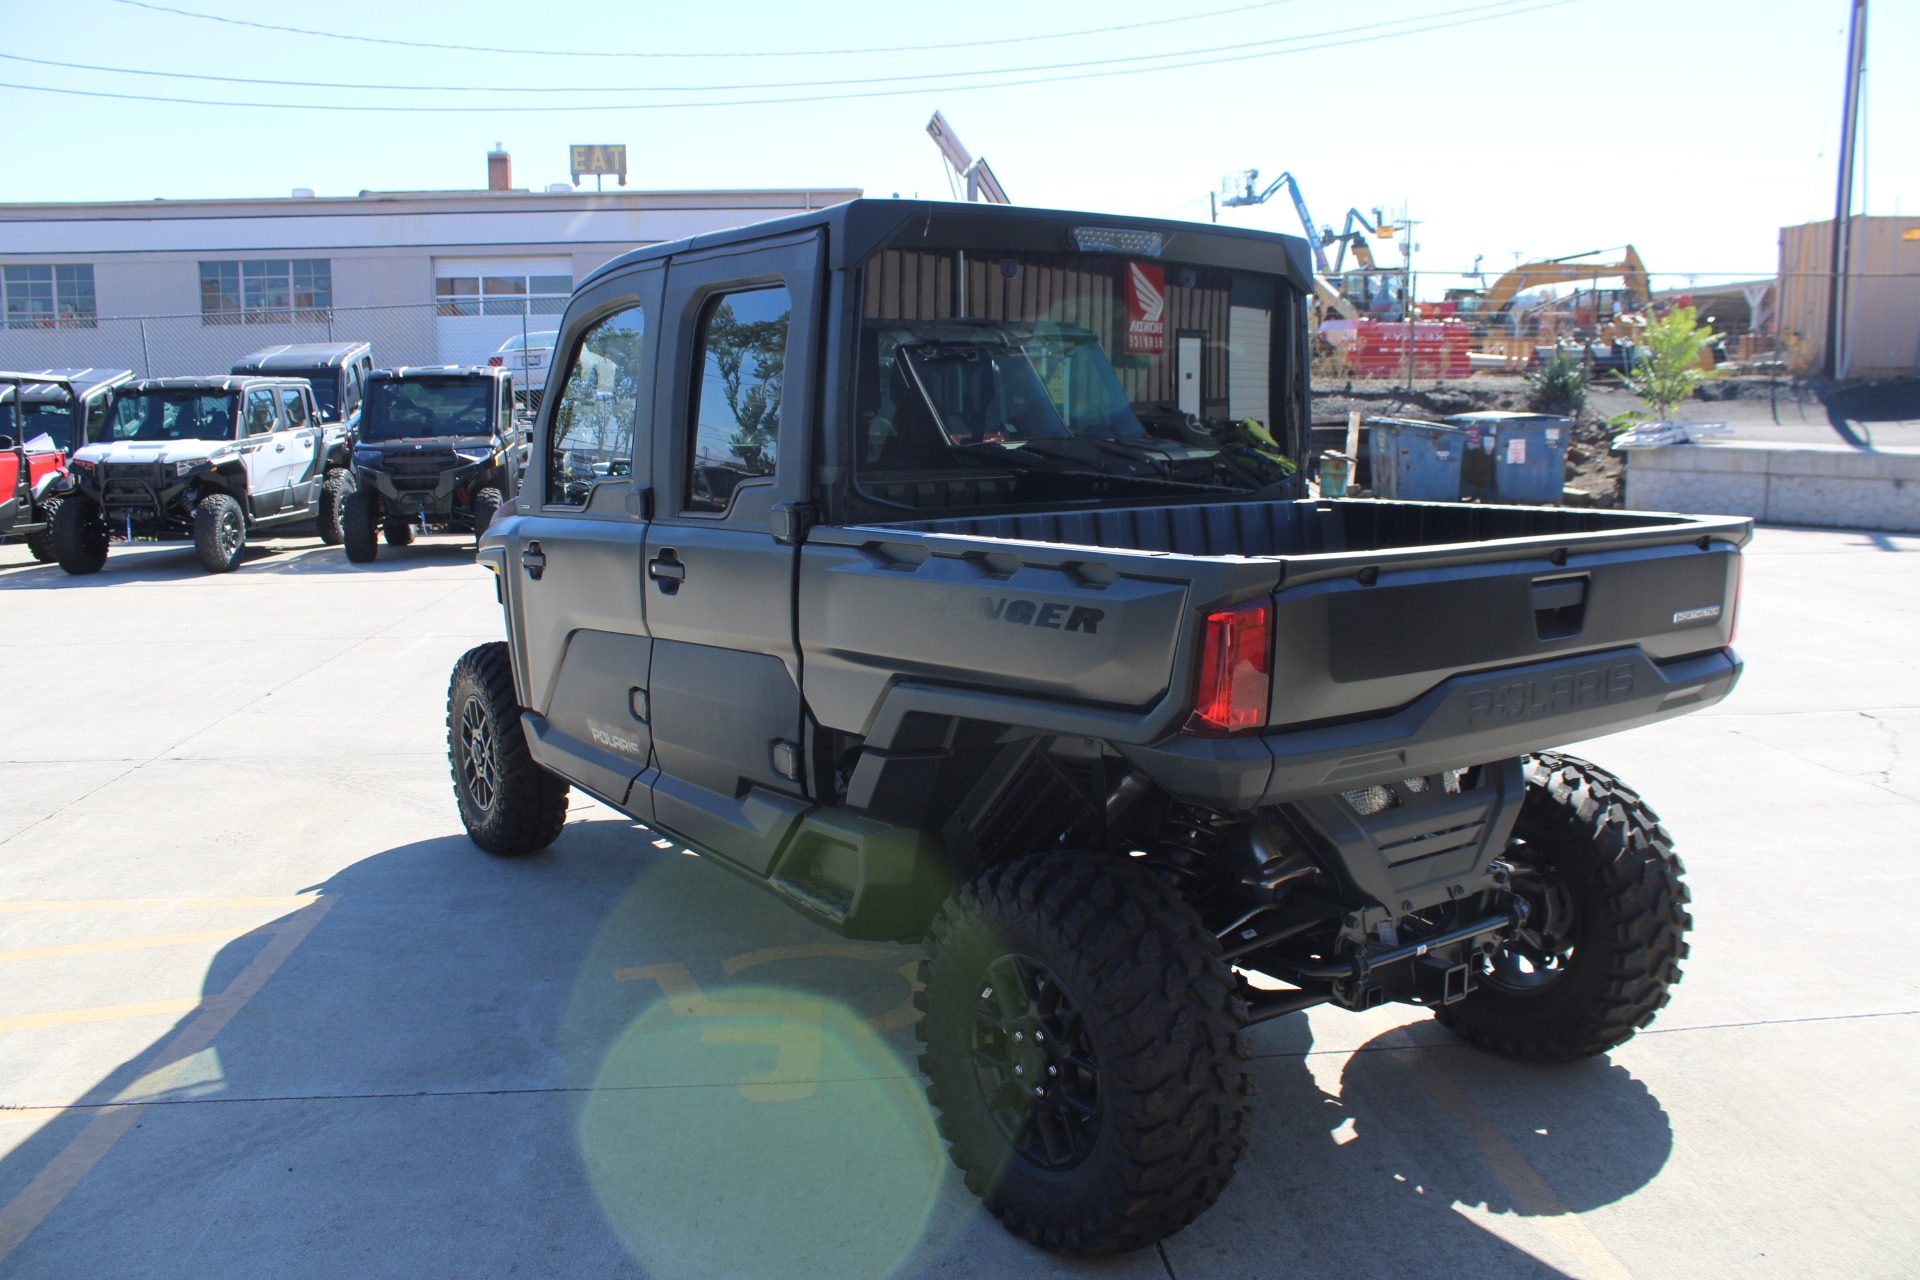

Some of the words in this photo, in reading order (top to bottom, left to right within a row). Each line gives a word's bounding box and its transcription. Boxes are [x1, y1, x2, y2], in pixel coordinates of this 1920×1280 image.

[573, 146, 624, 171] EAT
[1463, 663, 1634, 727] POLARIS
[591, 727, 640, 753] POLARIS
